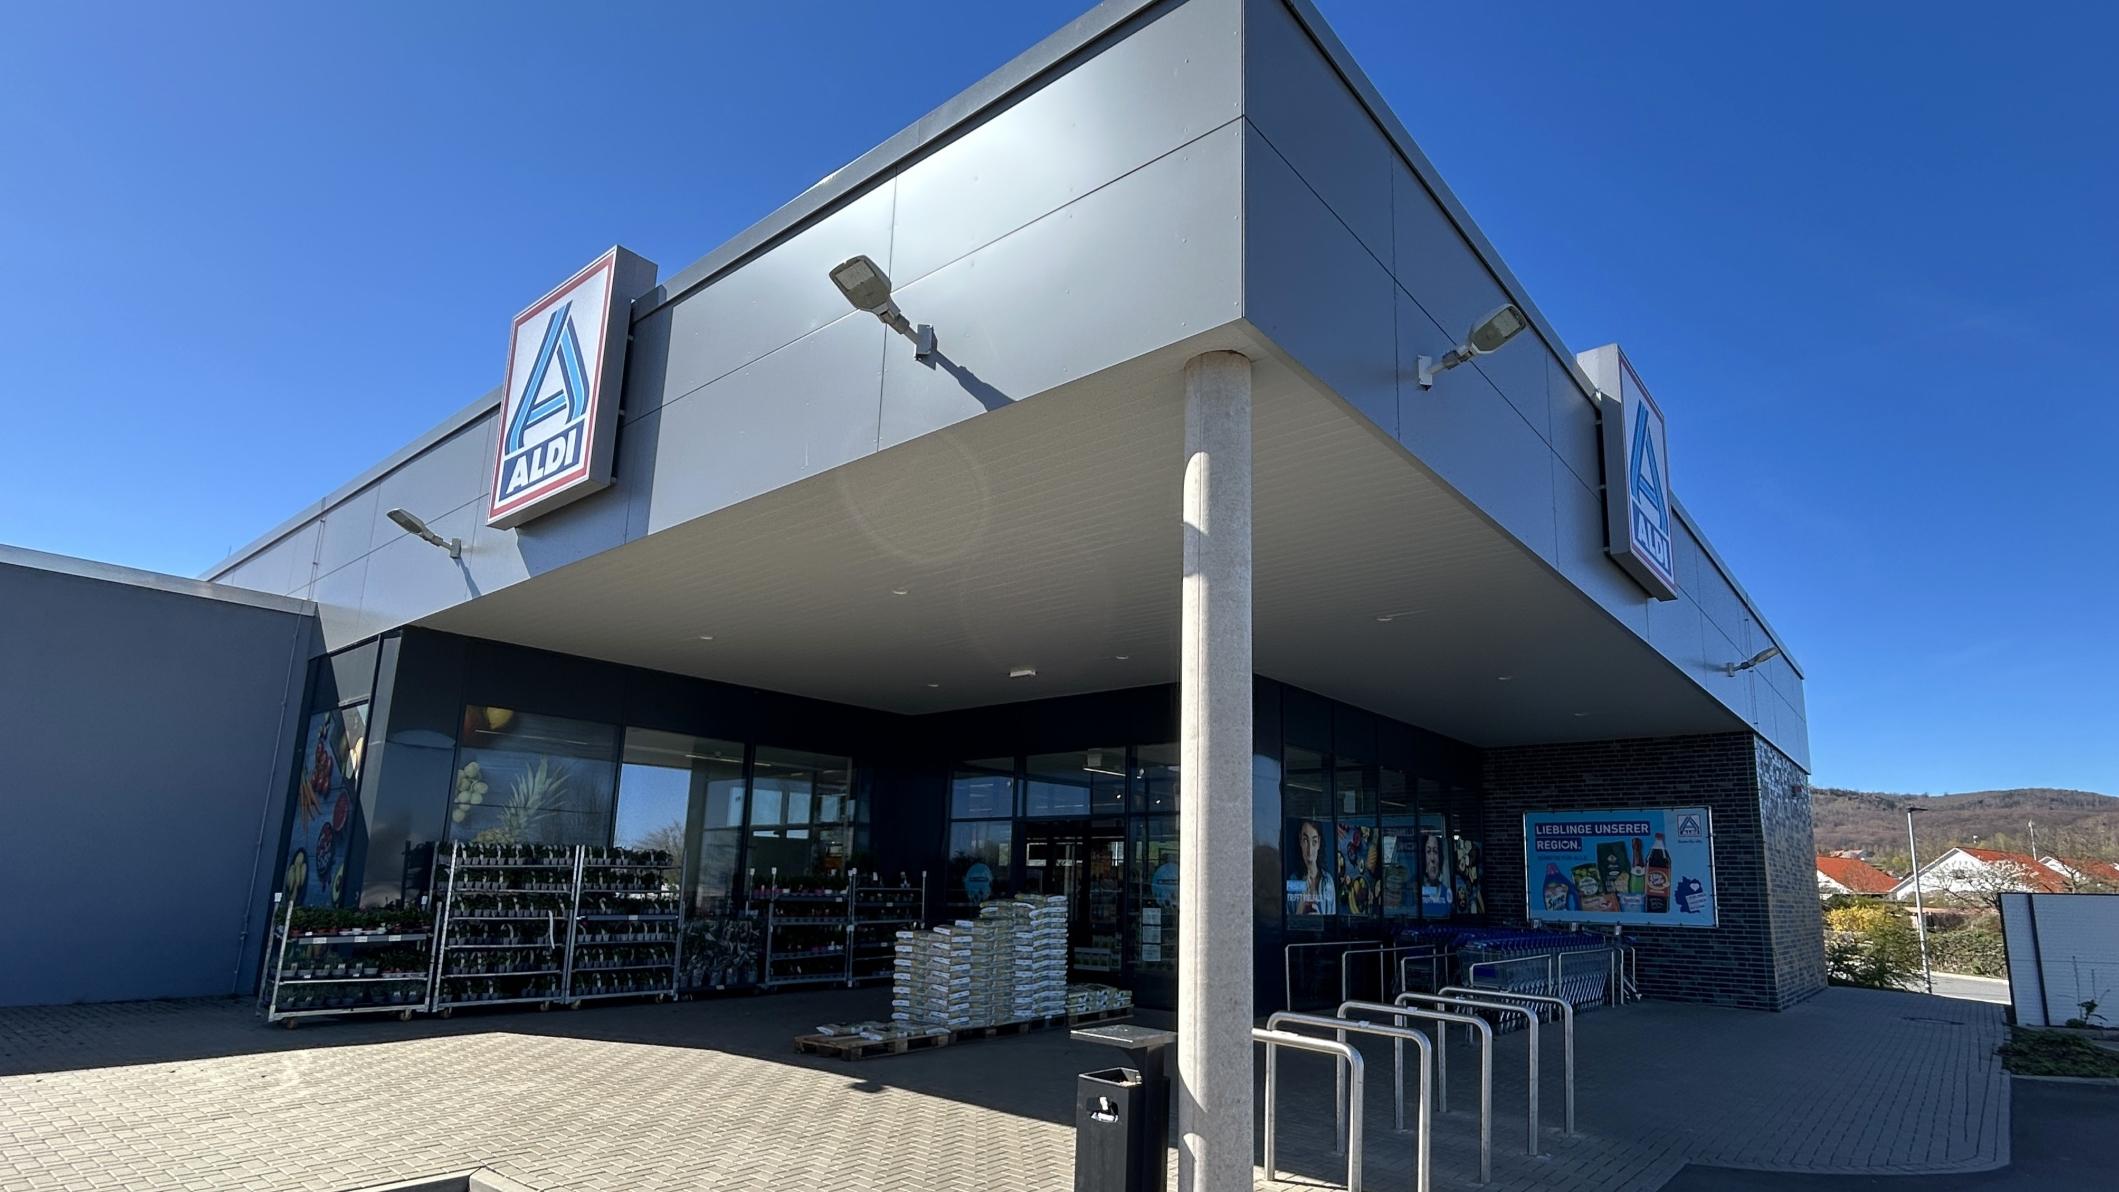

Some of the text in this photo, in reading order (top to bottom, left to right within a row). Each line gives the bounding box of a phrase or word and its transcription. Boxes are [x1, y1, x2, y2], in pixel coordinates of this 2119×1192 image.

[505, 429, 577, 494] ALDI
[1637, 513, 1670, 570] ALDI
[1536, 823, 1649, 835] LIEBLINGE UNSERER
